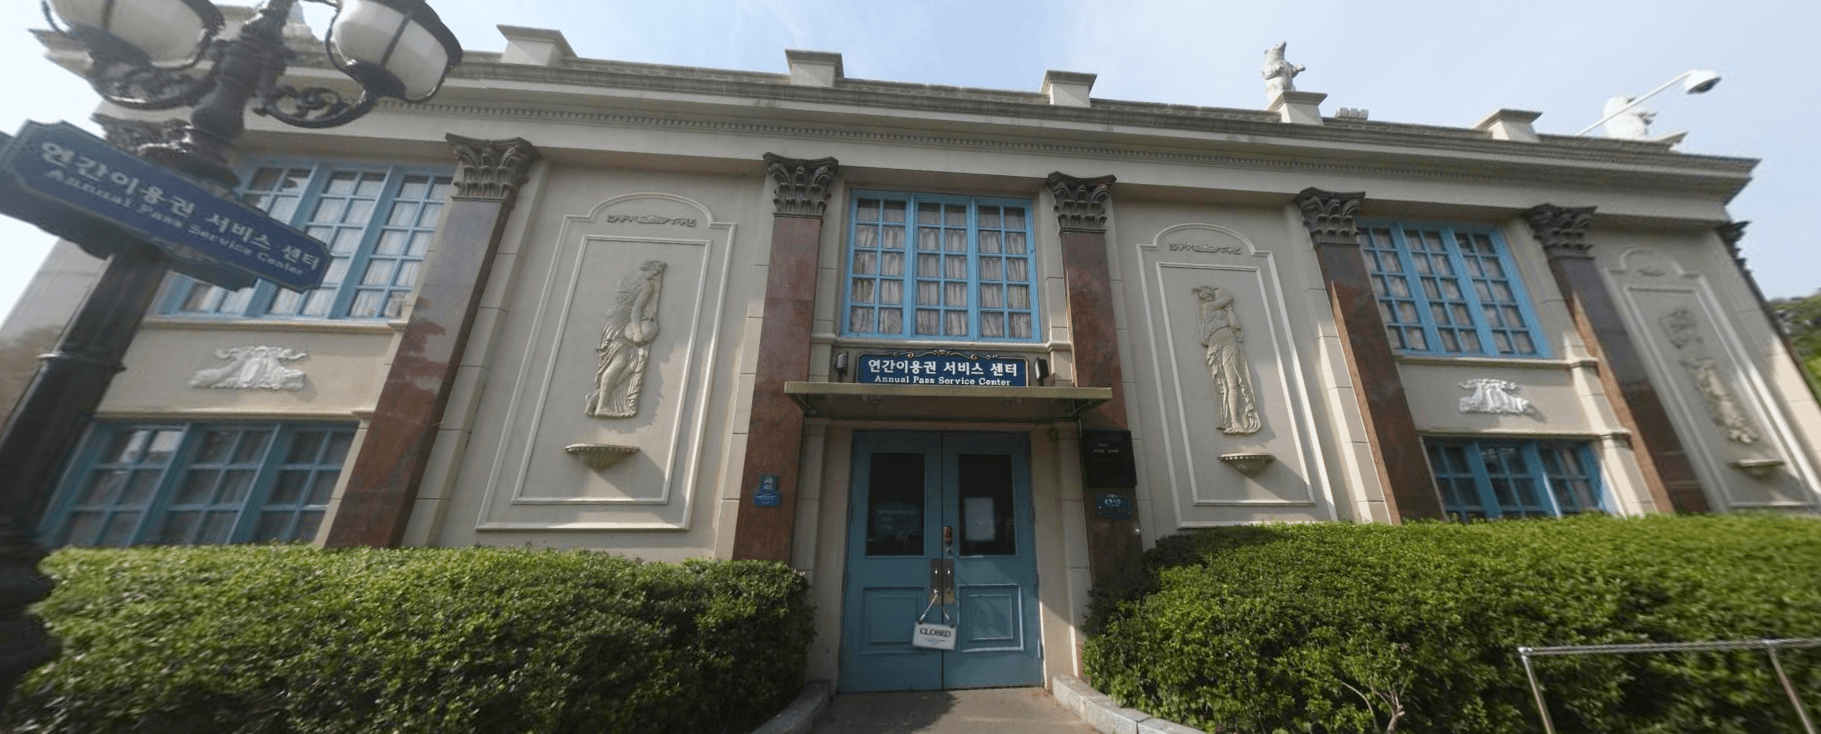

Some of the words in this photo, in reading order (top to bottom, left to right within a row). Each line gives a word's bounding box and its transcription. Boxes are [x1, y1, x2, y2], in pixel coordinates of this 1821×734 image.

[41, 140, 196, 218] 연간이용권
[206, 212, 271, 250] 서비스
[281, 244, 320, 270] 센터
[45, 168, 132, 207] Annual
[138, 201, 183, 229] Pass
[188, 224, 252, 256] Service
[256, 250, 304, 275] Center
[868, 359, 936, 375] 연간이용권
[943, 361, 984, 375] 서비스
[990, 363, 1017, 376] 센터
[874, 374, 909, 383] Annual
[913, 375, 935, 384] Pass
[938, 377, 975, 386] Service
[979, 378, 1010, 387] Center
[919, 627, 951, 638] CLOSED
